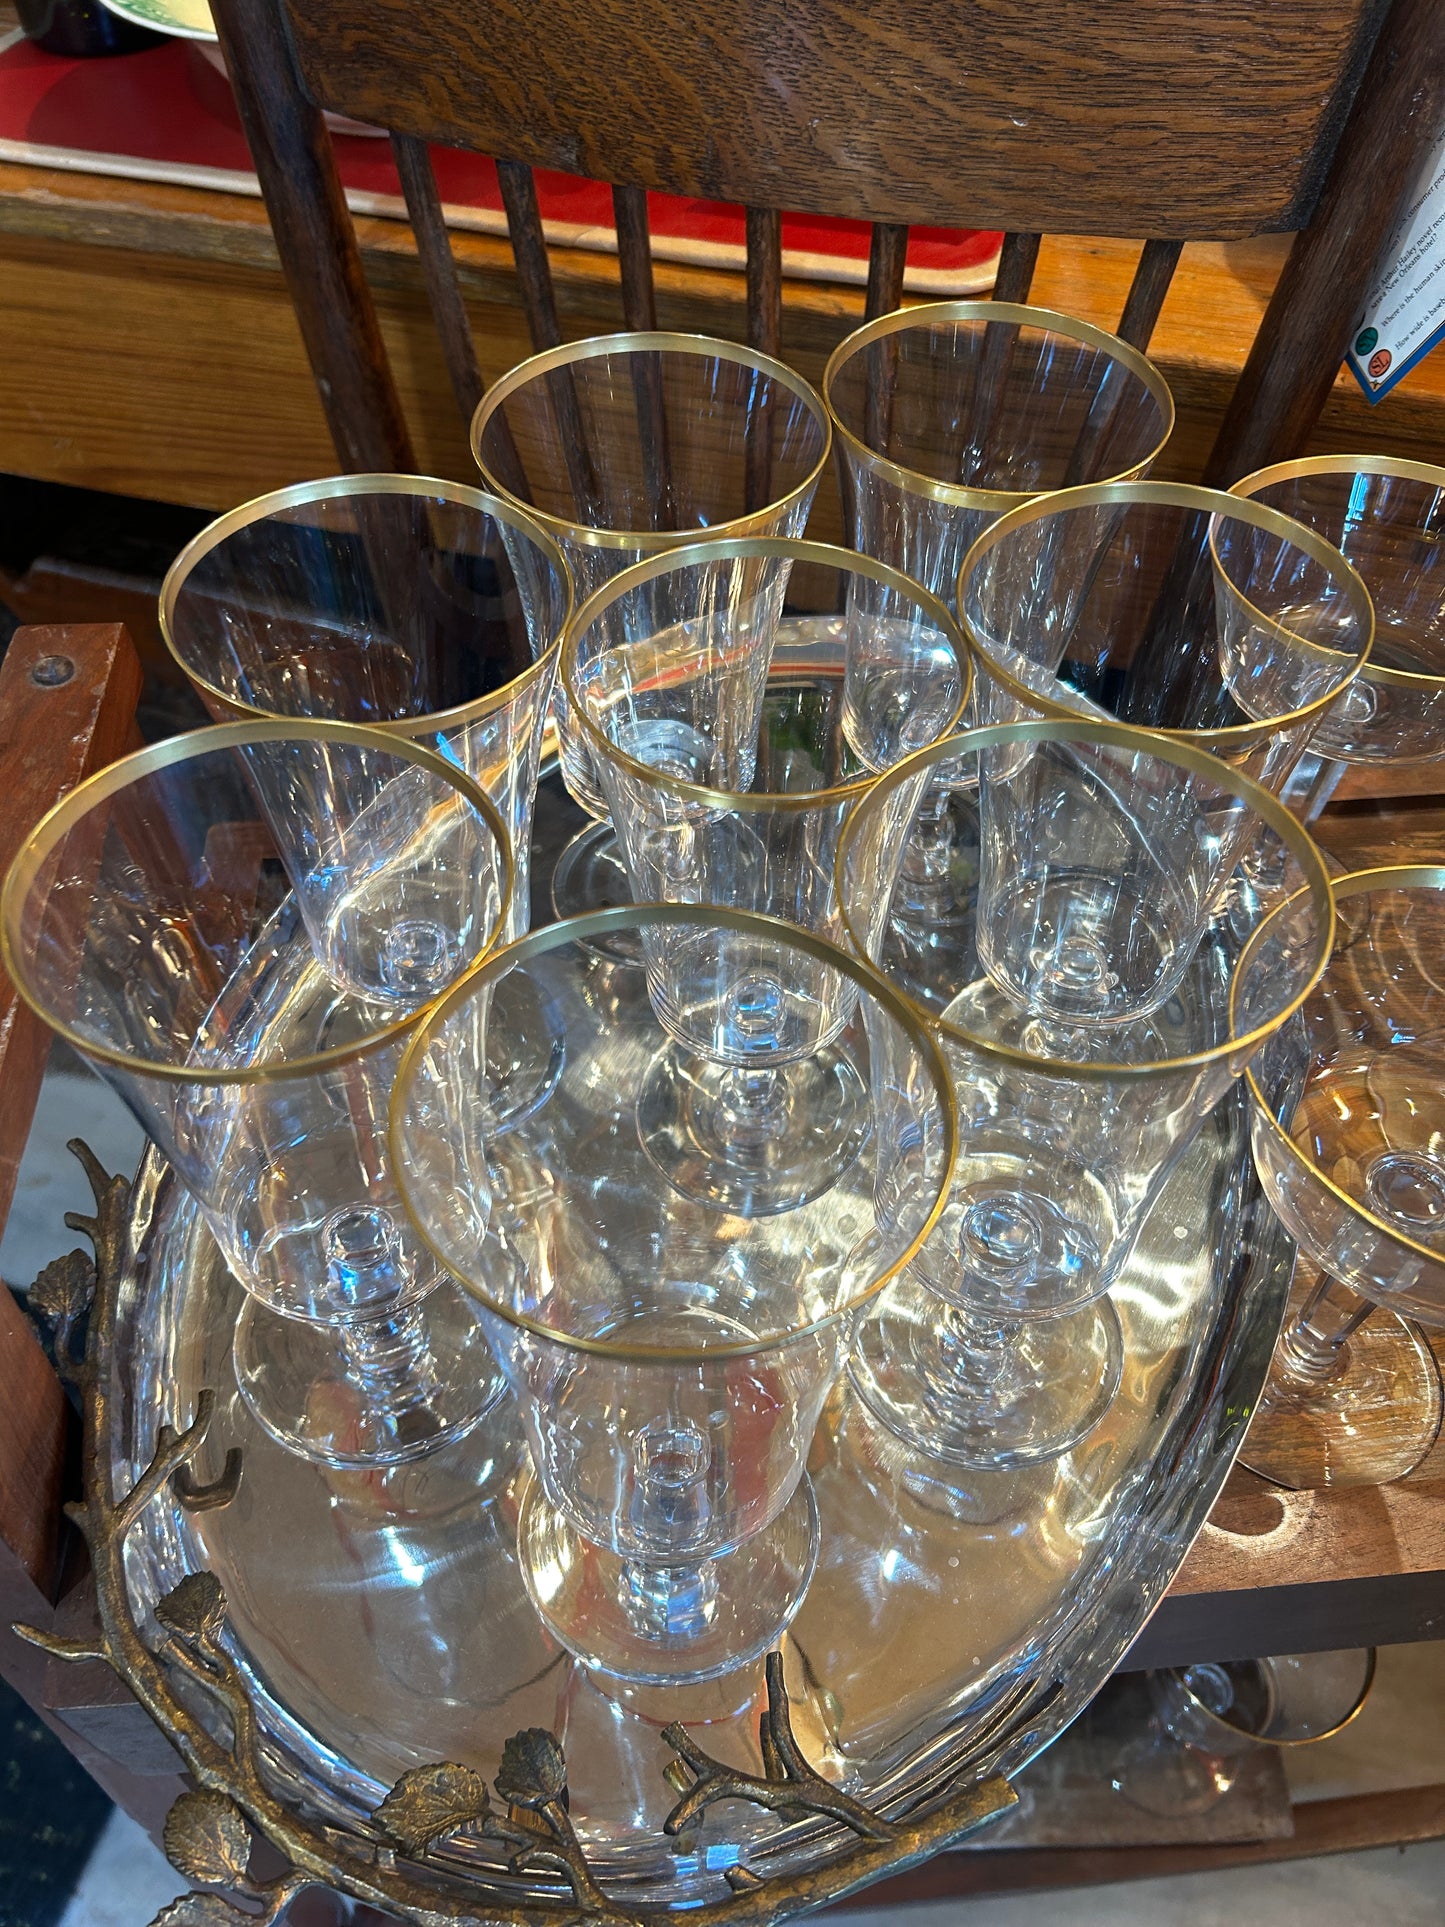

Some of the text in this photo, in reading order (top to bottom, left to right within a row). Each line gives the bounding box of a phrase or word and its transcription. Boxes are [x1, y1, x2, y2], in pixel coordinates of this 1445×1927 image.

[1407, 186, 1434, 218] consumer
[1380, 265, 1399, 287] Arthur
[1397, 246, 1417, 267] Hailey
[1416, 225, 1433, 246] novel
[1385, 277, 1399, 292] New
[1398, 254, 1421, 278] Orleans
[1418, 232, 1438, 255] hotel?
[1381, 308, 1400, 327] Where
[1404, 293, 1415, 303] the
[1413, 272, 1435, 294] human
[1394, 335, 1410, 350] How
[1409, 320, 1424, 336] wide
[1423, 314, 1430, 322] is
[1371, 356, 1389, 374] SL
